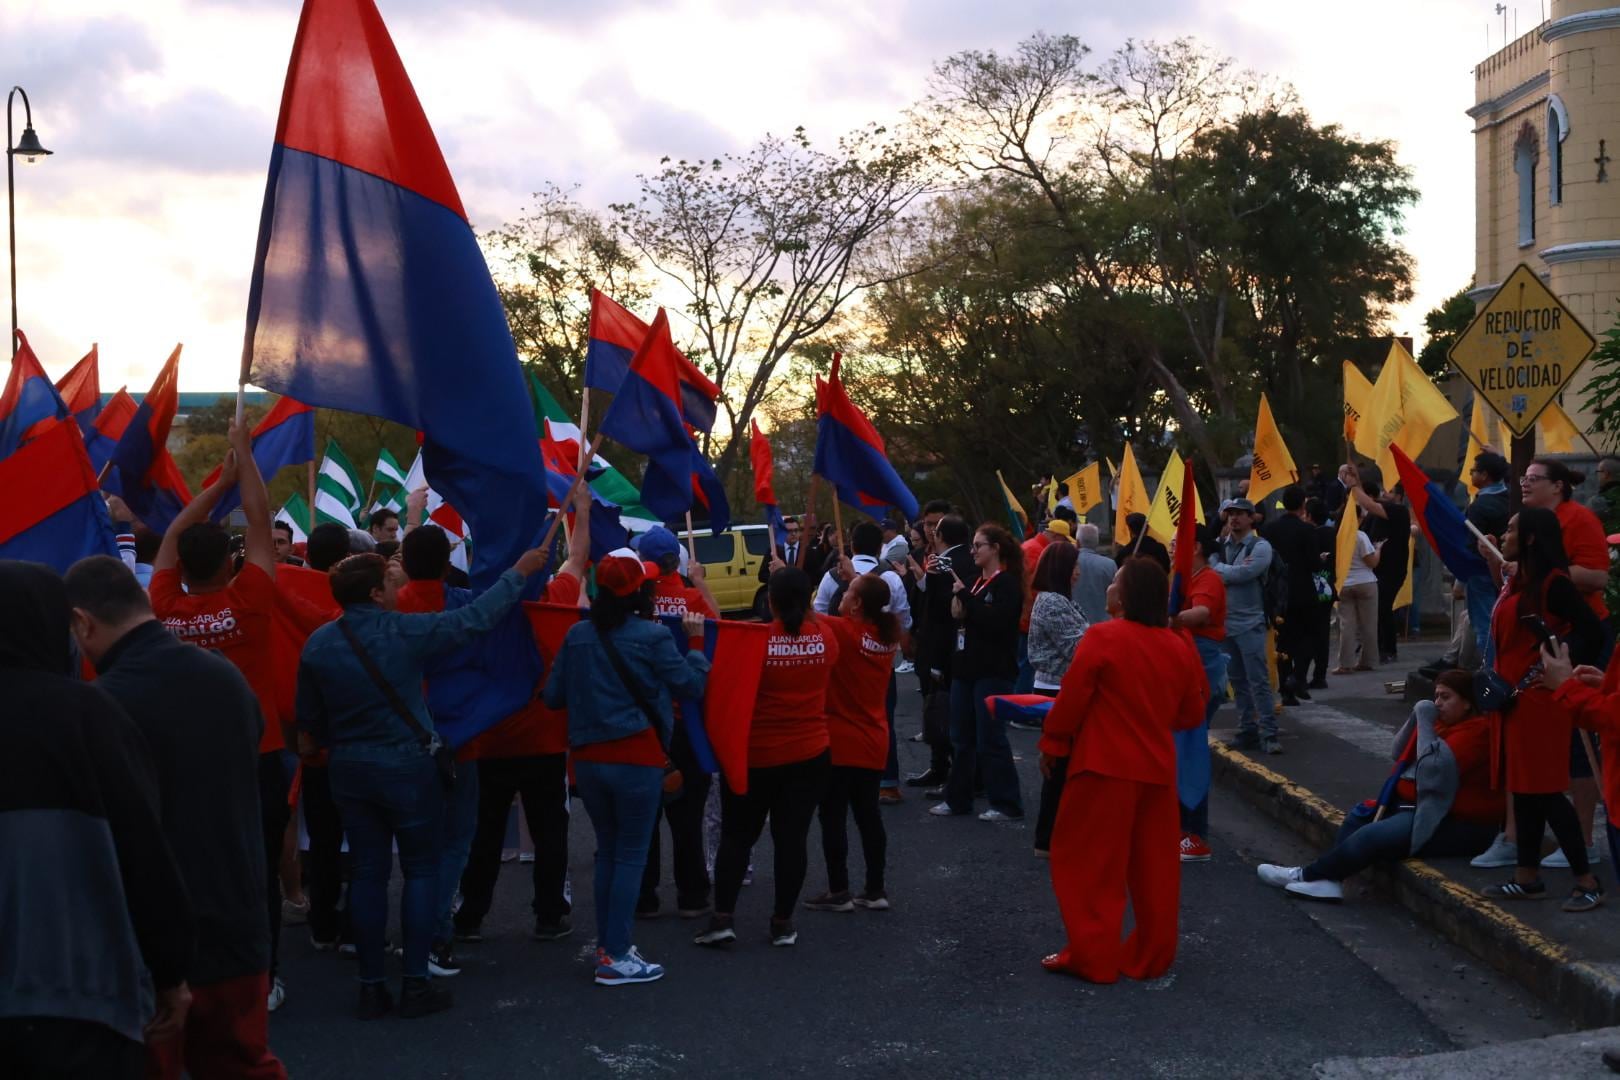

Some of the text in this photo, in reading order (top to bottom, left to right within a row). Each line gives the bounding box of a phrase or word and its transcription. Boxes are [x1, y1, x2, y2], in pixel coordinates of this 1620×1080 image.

[1485, 307, 1561, 335] REDUCTOR
[1507, 341, 1533, 359] DE
[1480, 363, 1561, 391] VELOCIDAD
[188, 607, 232, 625] CARLOS
[768, 634, 824, 644] JUAN CARLOS
[768, 642, 825, 656] HIDALGO
